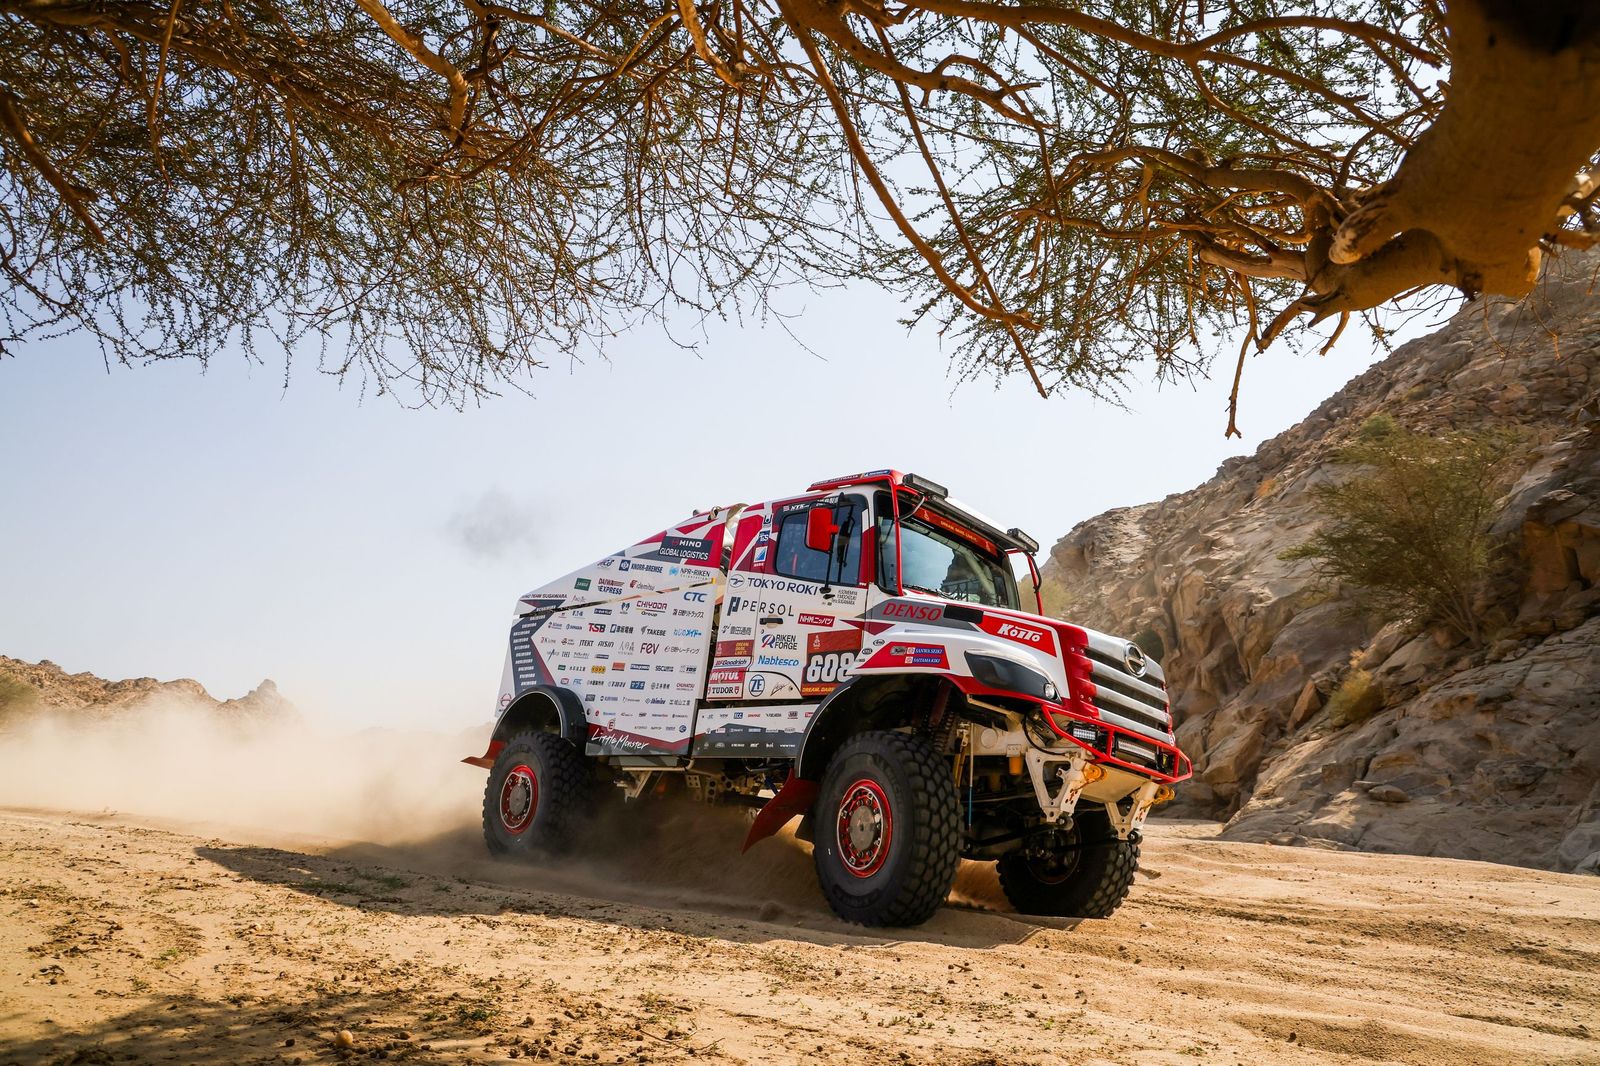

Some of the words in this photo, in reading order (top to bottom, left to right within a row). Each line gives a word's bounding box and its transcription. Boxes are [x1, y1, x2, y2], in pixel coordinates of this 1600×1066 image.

[660, 547, 679, 557] GLOBAL
[680, 550, 709, 560] LOGISTICS
[599, 585, 622, 595] EXPRESS
[748, 577, 786, 591] TOKYO
[787, 582, 819, 596] ROKI
[683, 591, 707, 603] CTC
[636, 600, 668, 610] CHIYODA
[742, 599, 794, 617] PERSOL
[883, 602, 942, 621] DENSO
[588, 622, 606, 633] TSB
[775, 633, 797, 642] RIKEN
[775, 641, 798, 650] FORGE
[757, 654, 799, 667] Nabtesco
[806, 652, 855, 683] 608
[710, 671, 739, 681] MOTUL
[712, 686, 733, 694] TUDOR
[751, 679, 763, 693] ZF
[614, 734, 650, 750] Monster
